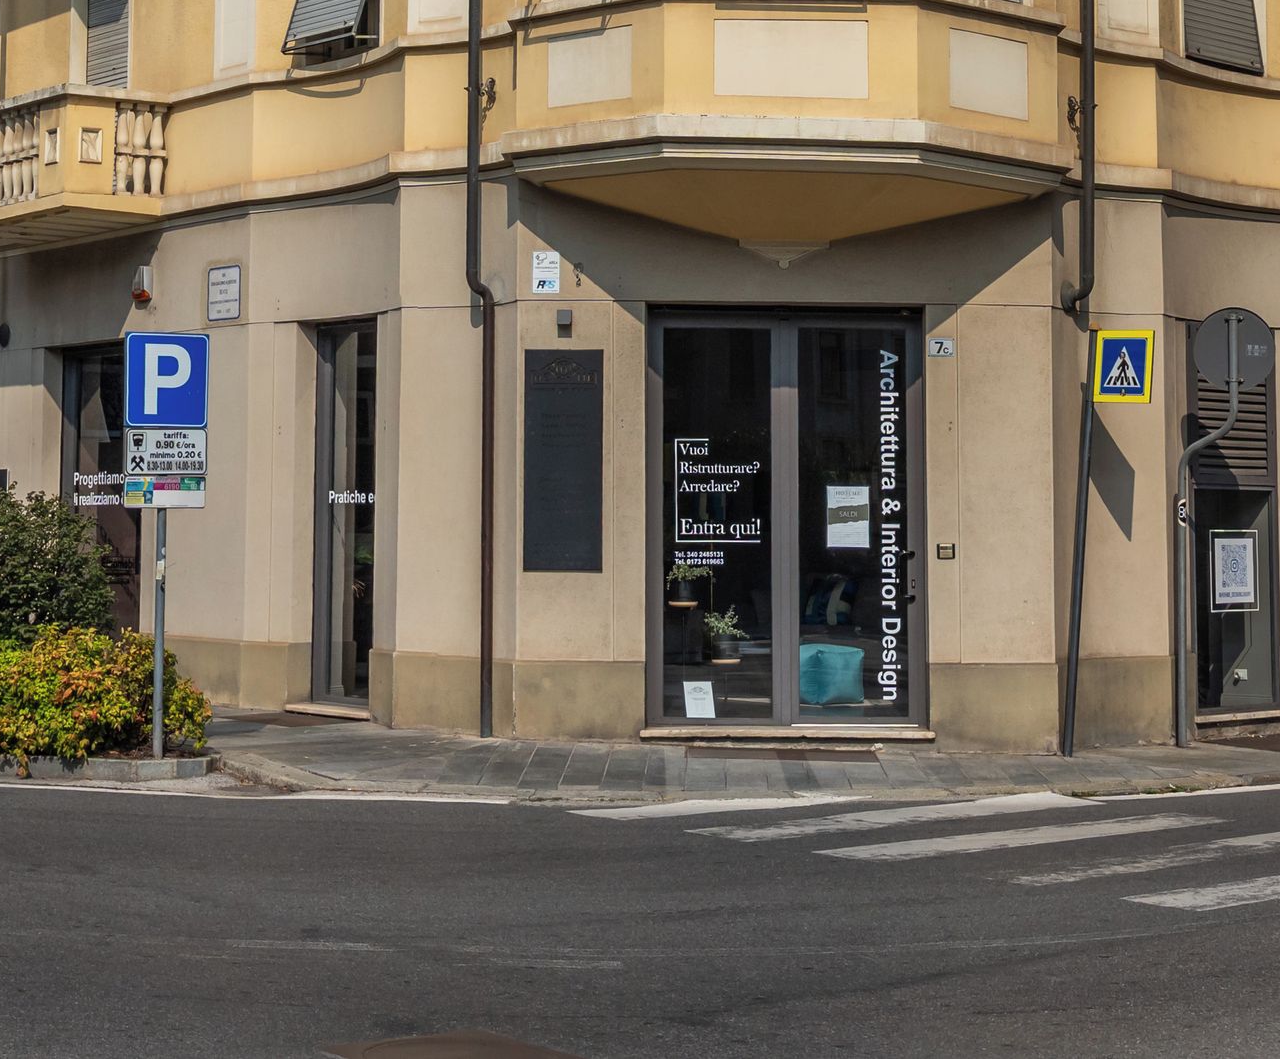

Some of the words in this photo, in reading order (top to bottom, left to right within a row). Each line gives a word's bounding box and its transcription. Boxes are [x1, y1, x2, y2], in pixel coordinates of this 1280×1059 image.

[144, 343, 192, 415] P
[880, 349, 899, 490] Architettura
[163, 431, 189, 439] tariffa:
[149, 451, 175, 459] minimo
[679, 443, 709, 456] Vuoi
[679, 461, 761, 474] Ristrutturare?
[73, 472, 125, 489] Progettiamo
[679, 479, 740, 492] Arredare?
[80, 492, 120, 506] realizziamo
[328, 490, 366, 504] Pratiche
[840, 510, 858, 518] SALDI
[881, 498, 901, 516] &
[680, 518, 726, 535] Entra
[730, 518, 761, 539] qui!
[881, 523, 901, 610] Interior
[877, 618, 902, 701] Design
